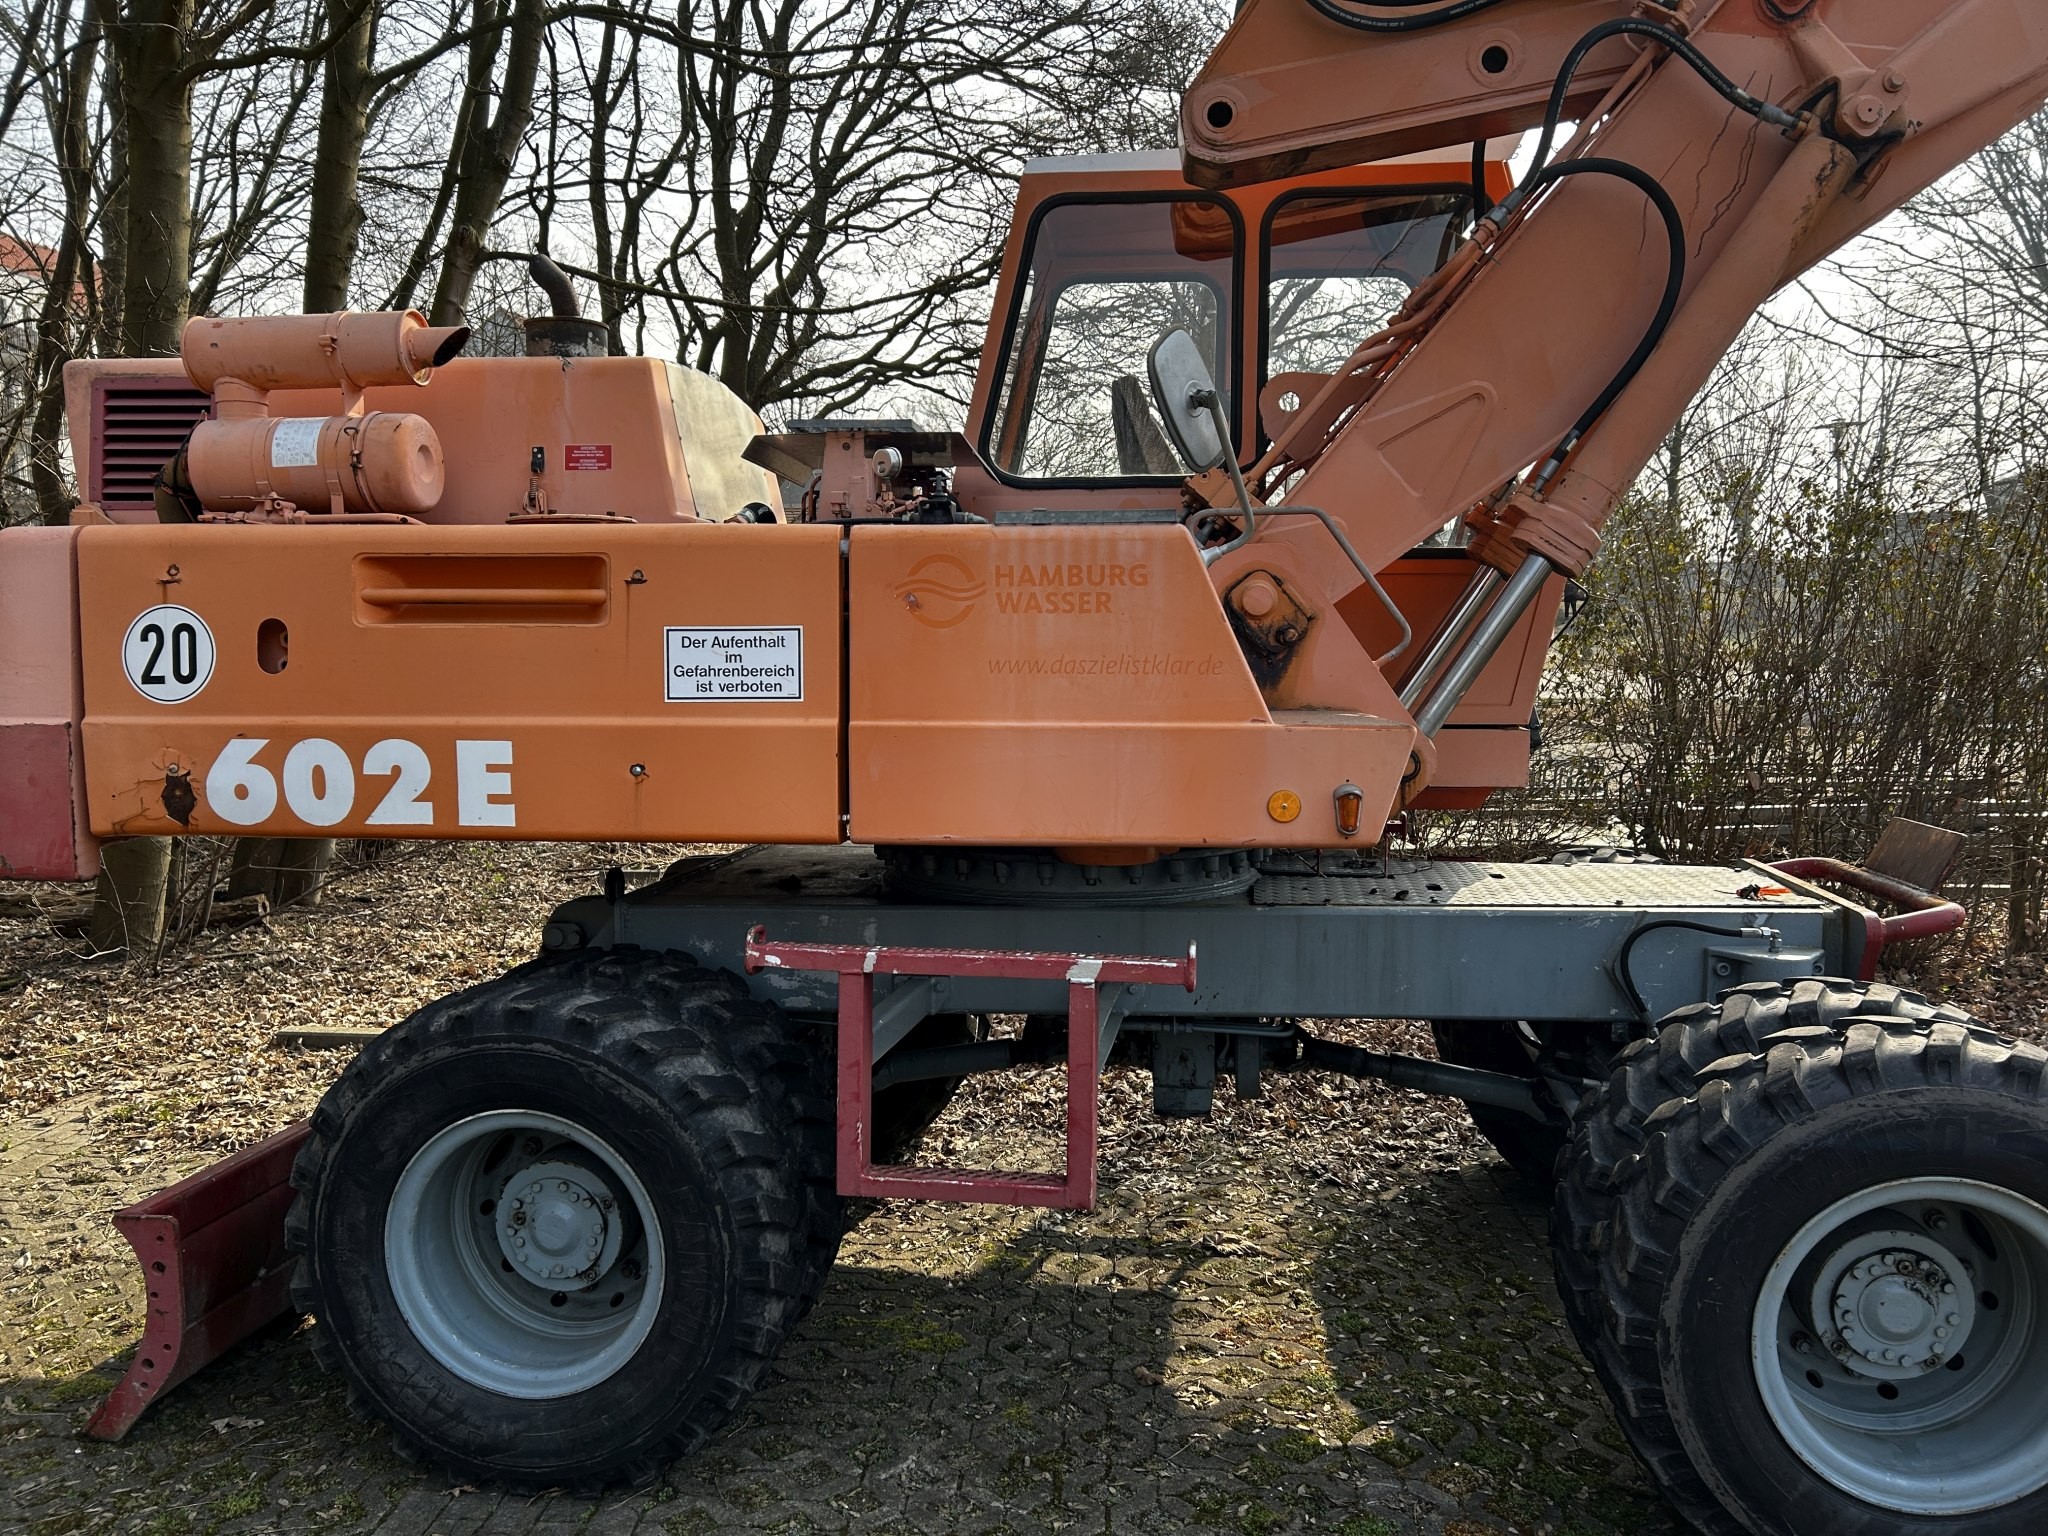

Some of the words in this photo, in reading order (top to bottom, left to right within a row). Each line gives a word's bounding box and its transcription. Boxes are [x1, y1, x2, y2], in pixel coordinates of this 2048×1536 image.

[994, 563, 1149, 587] HAMBURG
[996, 591, 1113, 614] WASSER
[681, 635, 707, 648] Der
[711, 635, 786, 648] Aufenthalt
[139, 622, 198, 686] 20
[725, 651, 742, 663] im
[673, 664, 795, 678] Gefahrenbereich
[696, 680, 713, 692] ist
[718, 680, 783, 692] verboten
[205, 737, 434, 827] 602
[456, 740, 517, 828] E
